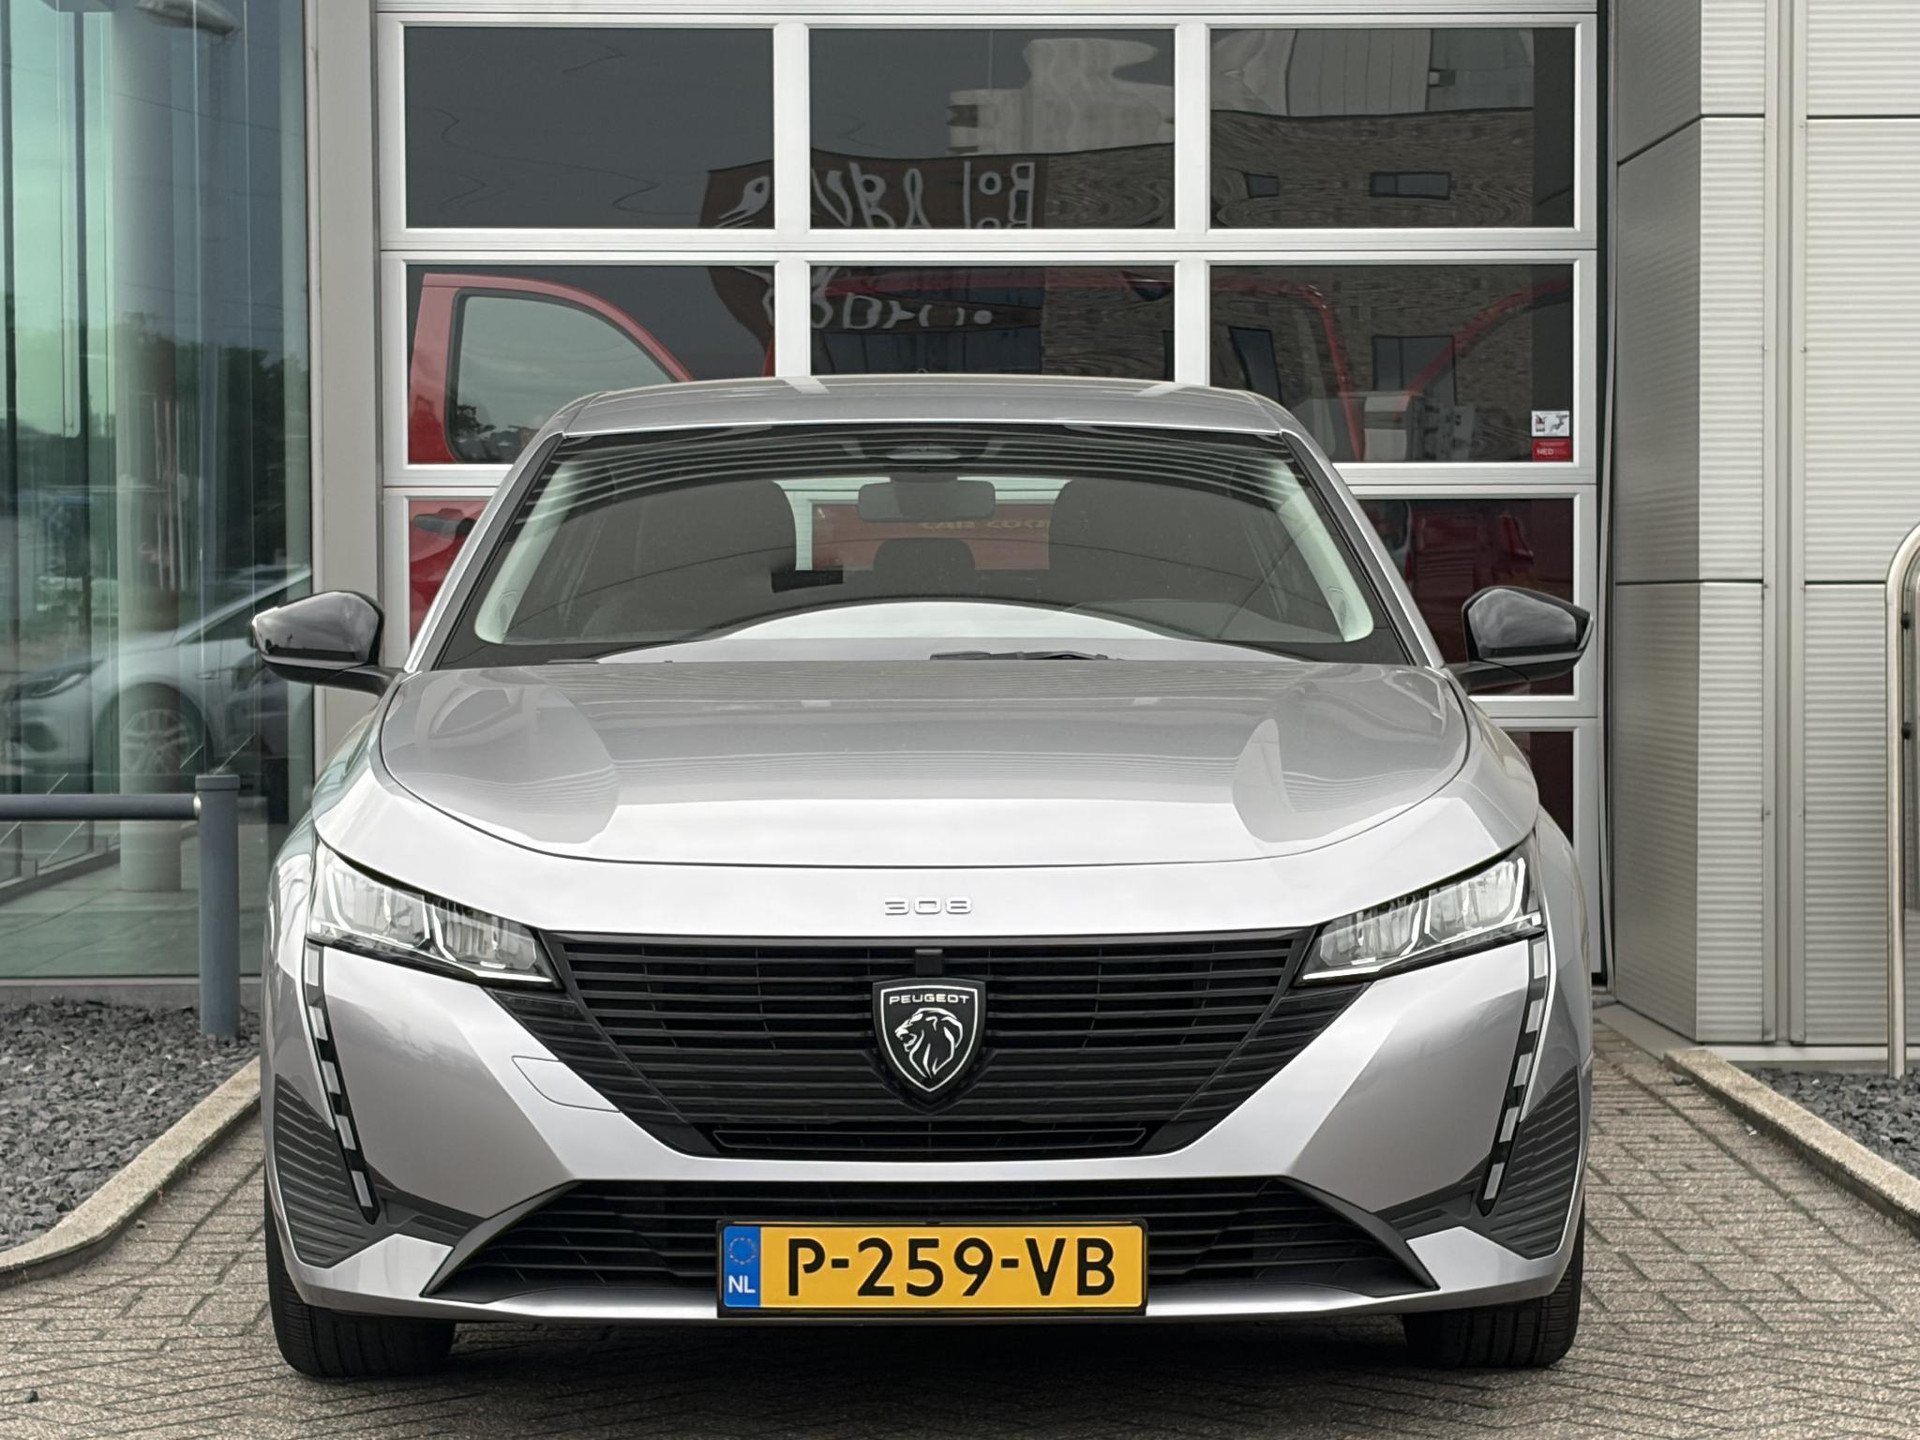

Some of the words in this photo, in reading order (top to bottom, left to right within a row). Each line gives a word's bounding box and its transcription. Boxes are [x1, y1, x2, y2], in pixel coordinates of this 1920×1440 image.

[884, 897, 973, 915] 308
[889, 993, 970, 1005] PEUGEOT
[788, 1237, 1115, 1297] P-259-VB
[728, 1275, 756, 1294] NL
